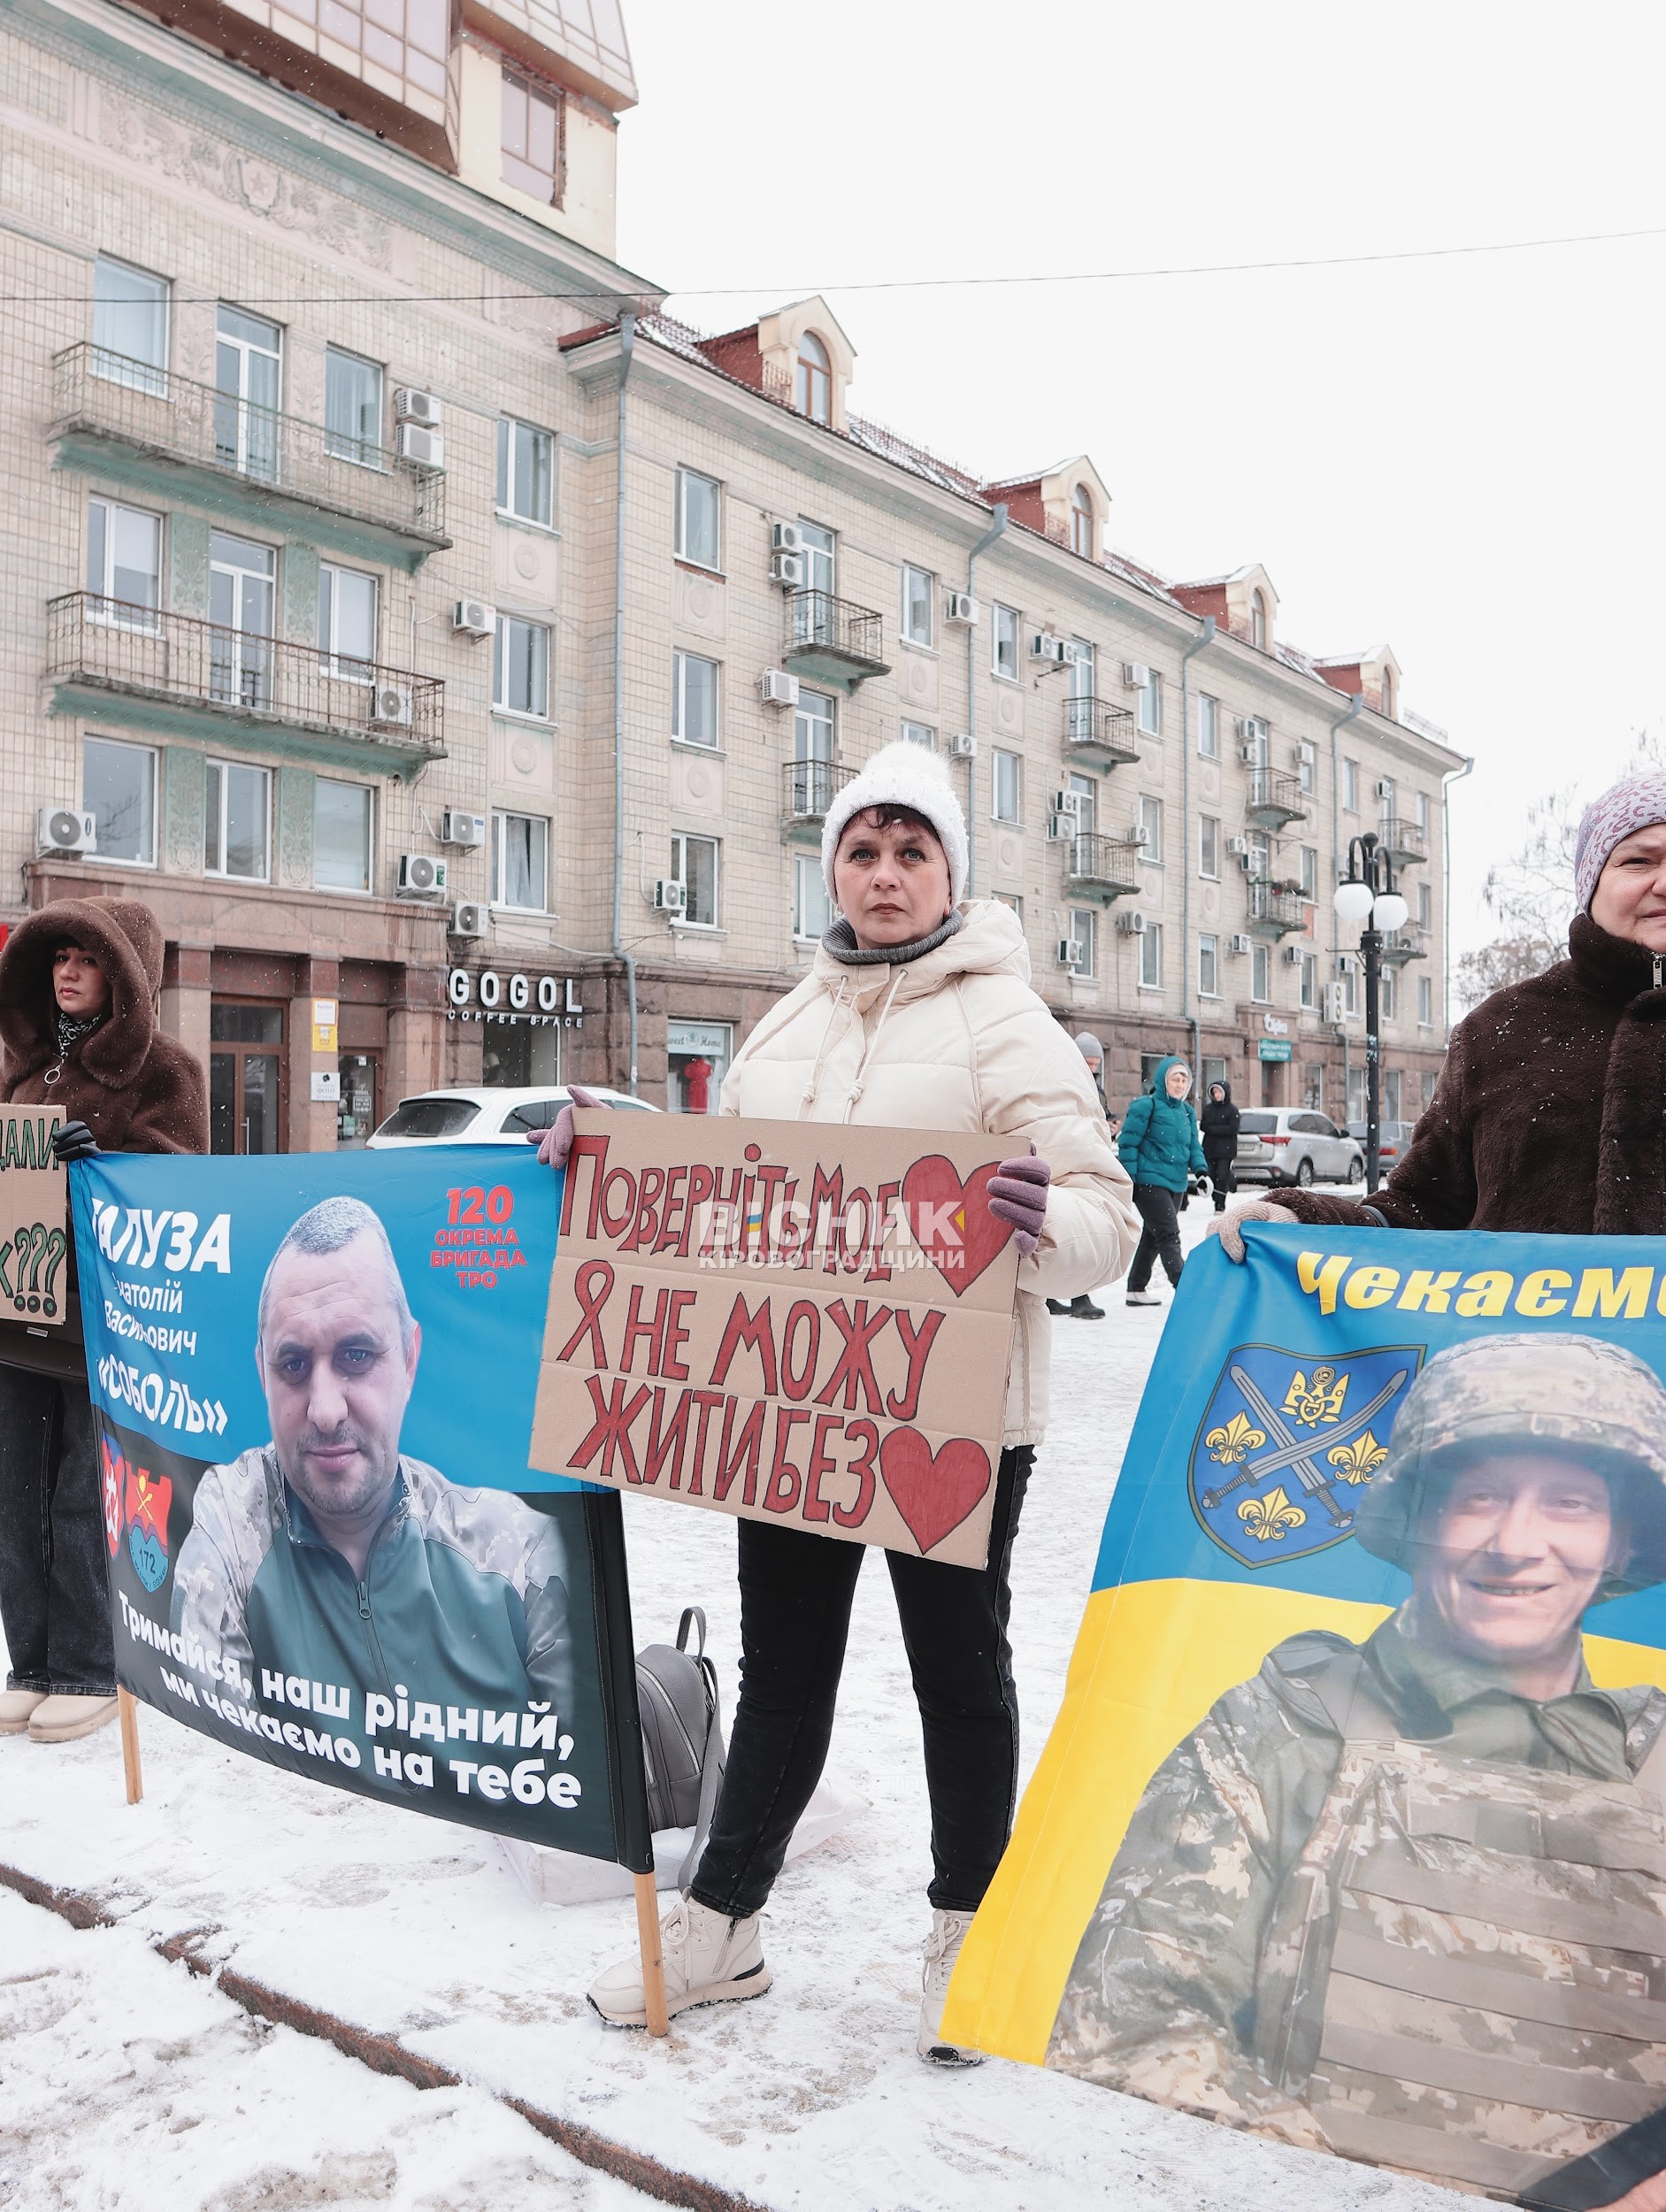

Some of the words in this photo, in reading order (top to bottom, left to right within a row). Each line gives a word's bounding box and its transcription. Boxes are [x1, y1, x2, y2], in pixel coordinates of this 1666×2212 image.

[449, 968, 583, 1013] GOGOL
[449, 1010, 517, 1025] COFFEE
[530, 1015, 583, 1029] SPACE
[0, 1118, 59, 1171] АЛИ
[447, 1185, 514, 1225] 120
[434, 1228, 519, 1247] ОКРЕМА
[430, 1249, 527, 1270] БРИГАДА
[456, 1271, 497, 1288] ТРО
[112, 1271, 183, 1313] натолій
[1296, 1251, 1666, 1319] Чекаєм
[557, 1259, 615, 1369] Я
[620, 1285, 697, 1380] НЕ
[708, 1292, 946, 1421] МОЖУ
[98, 1354, 228, 1436] «СОБОЛЬ»
[140, 1548, 156, 1574] 172
[119, 1590, 252, 1700] Тримайся,
[261, 1667, 351, 1720] наш
[365, 1685, 575, 1760] рідний,
[159, 1666, 201, 1709] ми
[202, 1686, 362, 1768] чекаємо
[372, 1745, 434, 1787] на
[449, 1756, 583, 1809] тебе
